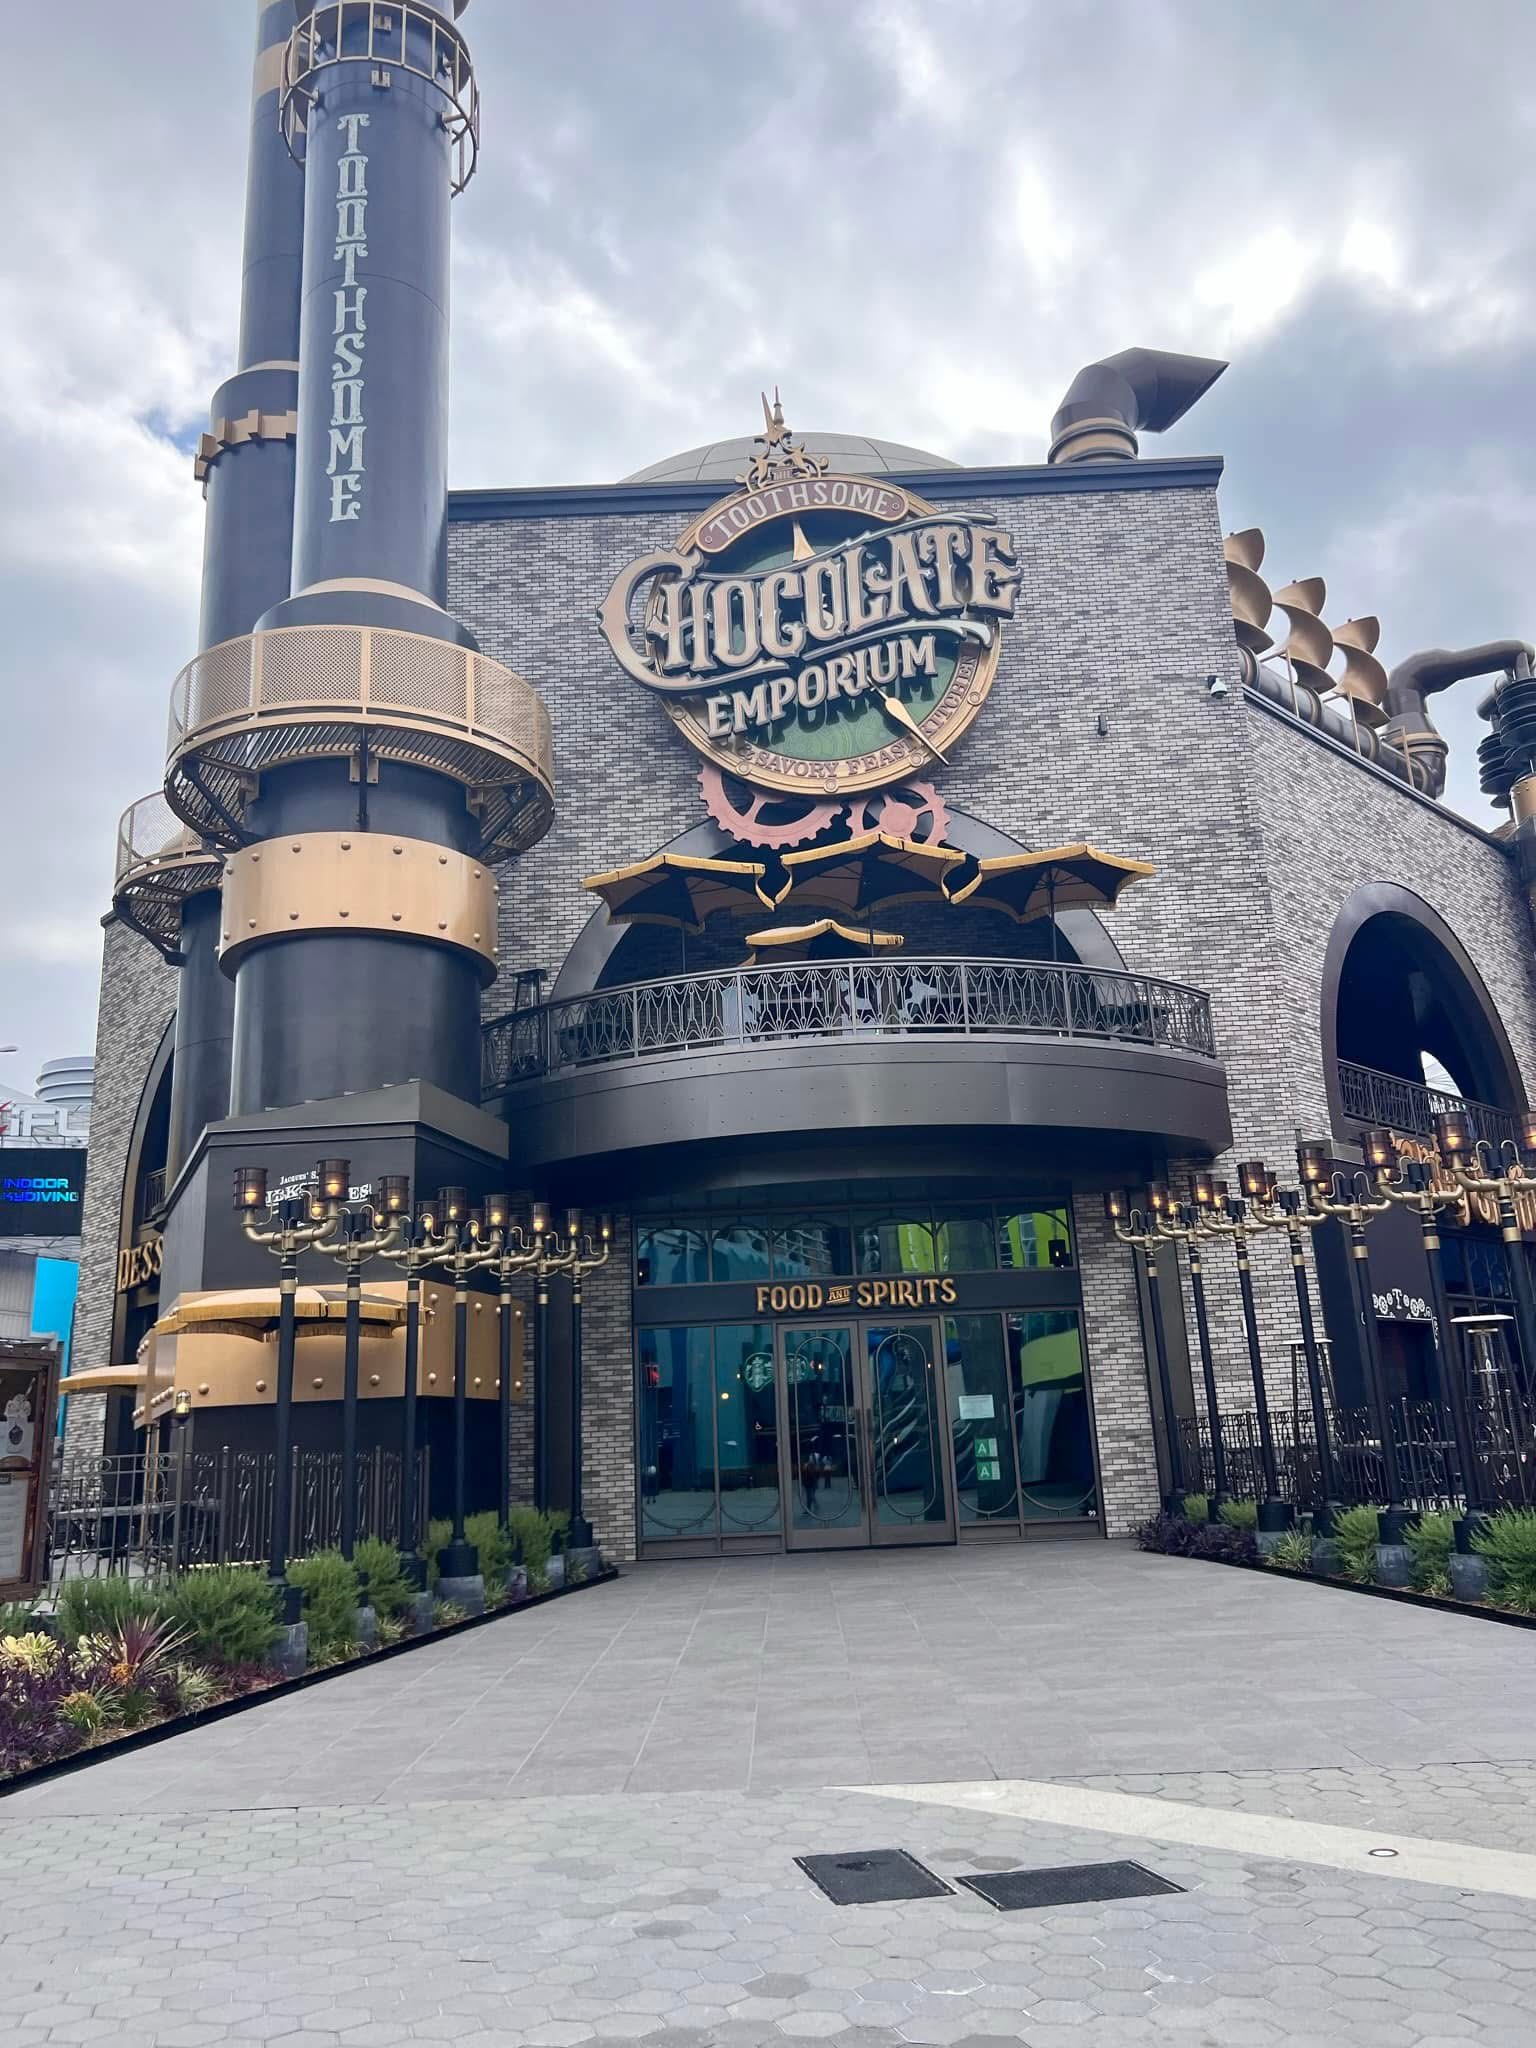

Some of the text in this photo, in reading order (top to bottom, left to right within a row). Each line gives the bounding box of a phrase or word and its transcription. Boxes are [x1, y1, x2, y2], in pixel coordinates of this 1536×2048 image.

[326, 112, 370, 523] TOOTHSOME
[708, 481, 890, 541] TOOTHSOME
[597, 523, 1023, 690] CHOCOLATE
[706, 634, 938, 738] EMPORIUM
[755, 750, 839, 778] SAVORY
[3, 1177, 69, 1189] INDOOR
[756, 1278, 957, 1312] FOOD AND SPIRITS
[978, 1443, 987, 1454] A
[980, 1466, 990, 1478] A
